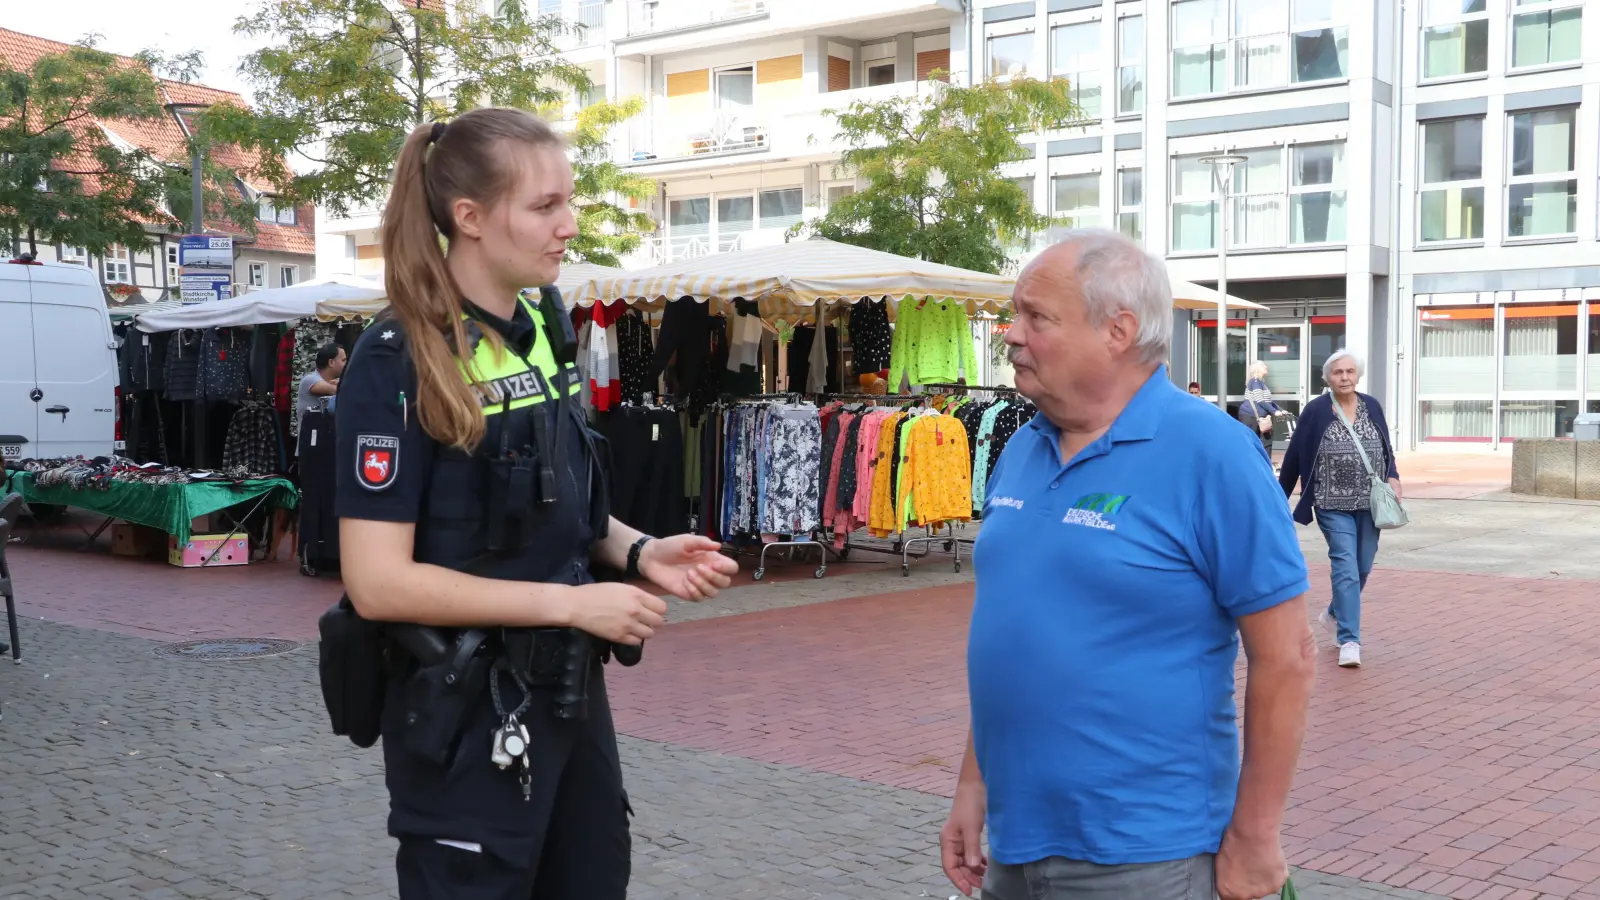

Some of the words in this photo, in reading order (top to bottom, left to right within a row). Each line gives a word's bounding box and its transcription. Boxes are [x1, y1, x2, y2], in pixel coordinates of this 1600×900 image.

[360, 437, 397, 448] POLIZEI
[5, 446, 20, 455] 559
[1067, 507, 1104, 520] DEUTSCHE
